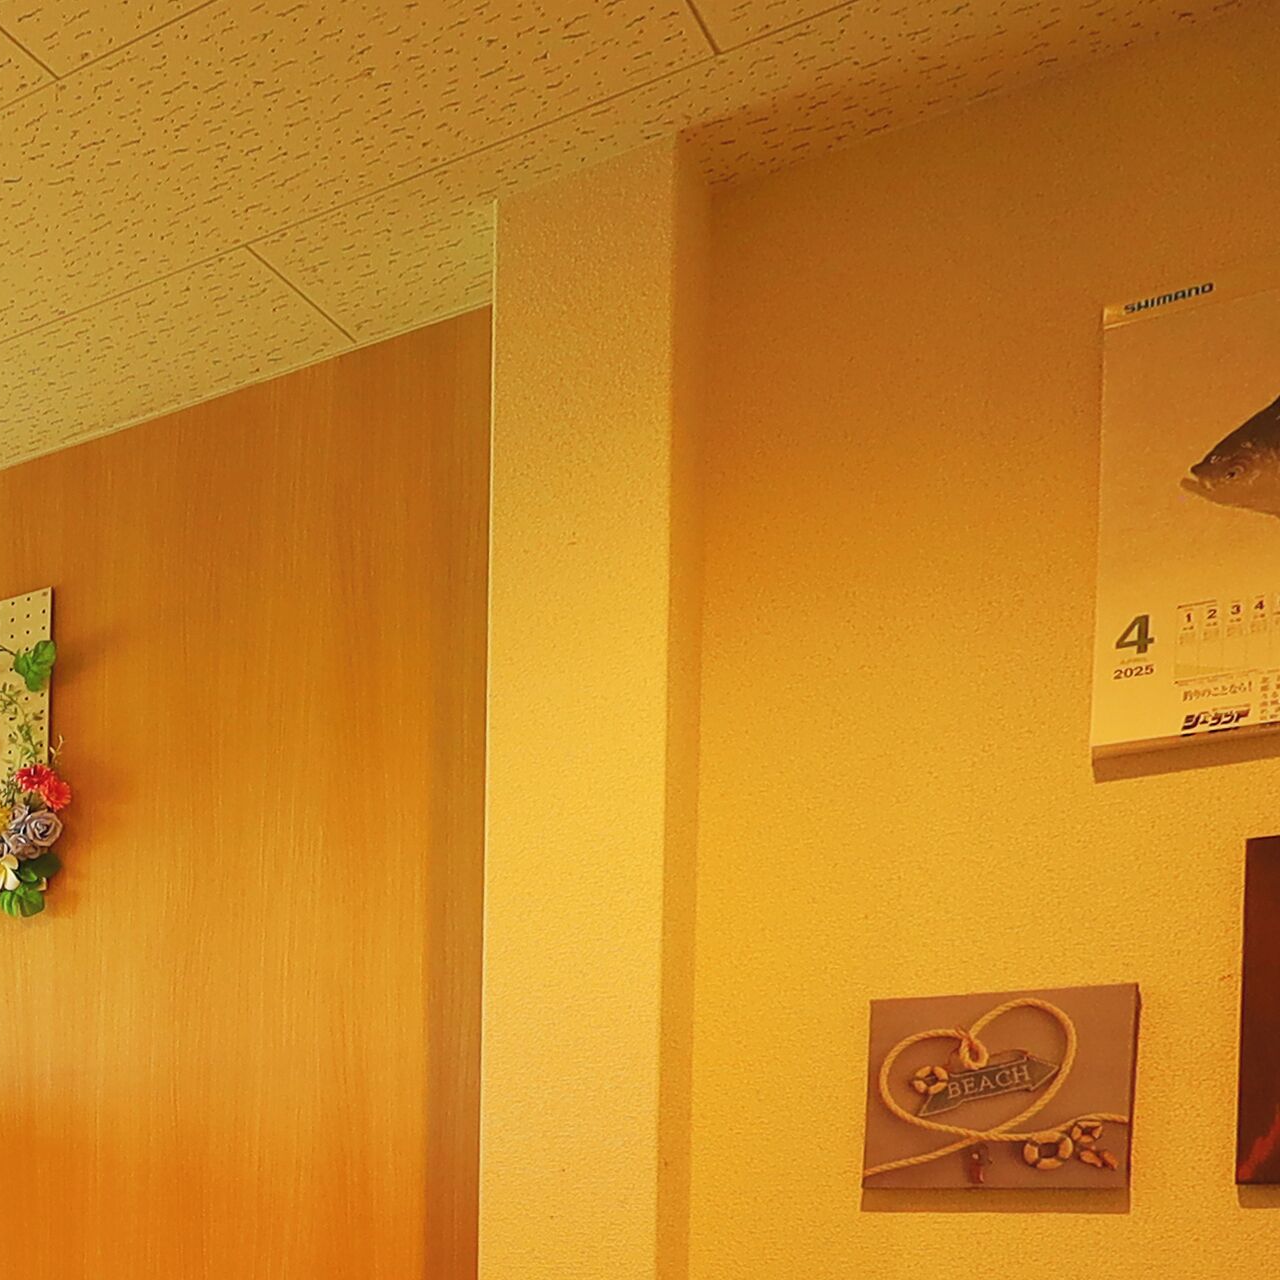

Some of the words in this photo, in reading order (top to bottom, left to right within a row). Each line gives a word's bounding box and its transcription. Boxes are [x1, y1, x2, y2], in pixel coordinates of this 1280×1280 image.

[1124, 282, 1214, 313] SHIMANO
[1115, 614, 1155, 654] 4
[1113, 664, 1154, 680] 2025
[947, 1065, 1031, 1100] BEACH
